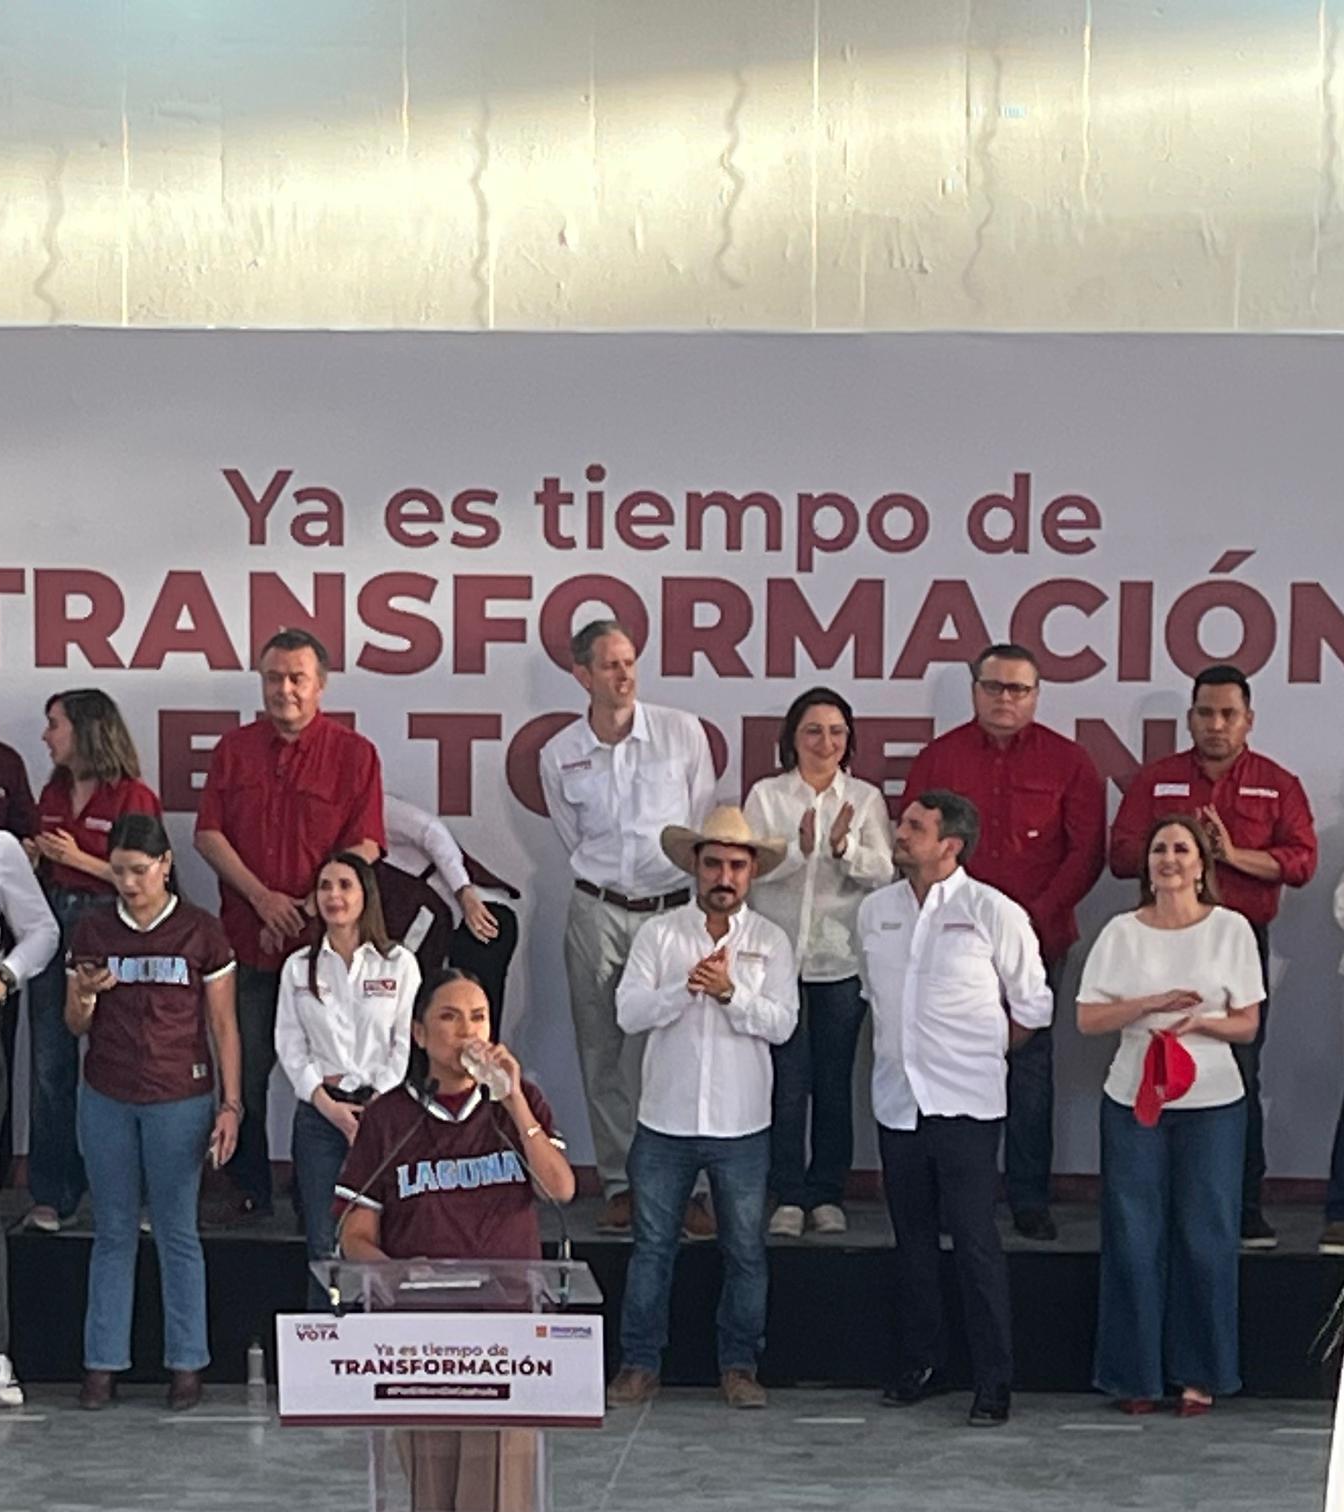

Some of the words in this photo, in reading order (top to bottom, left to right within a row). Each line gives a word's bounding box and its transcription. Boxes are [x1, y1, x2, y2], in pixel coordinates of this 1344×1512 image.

[223, 468, 345, 548] Ya
[385, 488, 502, 549] es
[534, 464, 930, 573] tiempo
[966, 472, 1102, 555] de
[331, 1355, 553, 1376] TRANSFORMACIÓN
